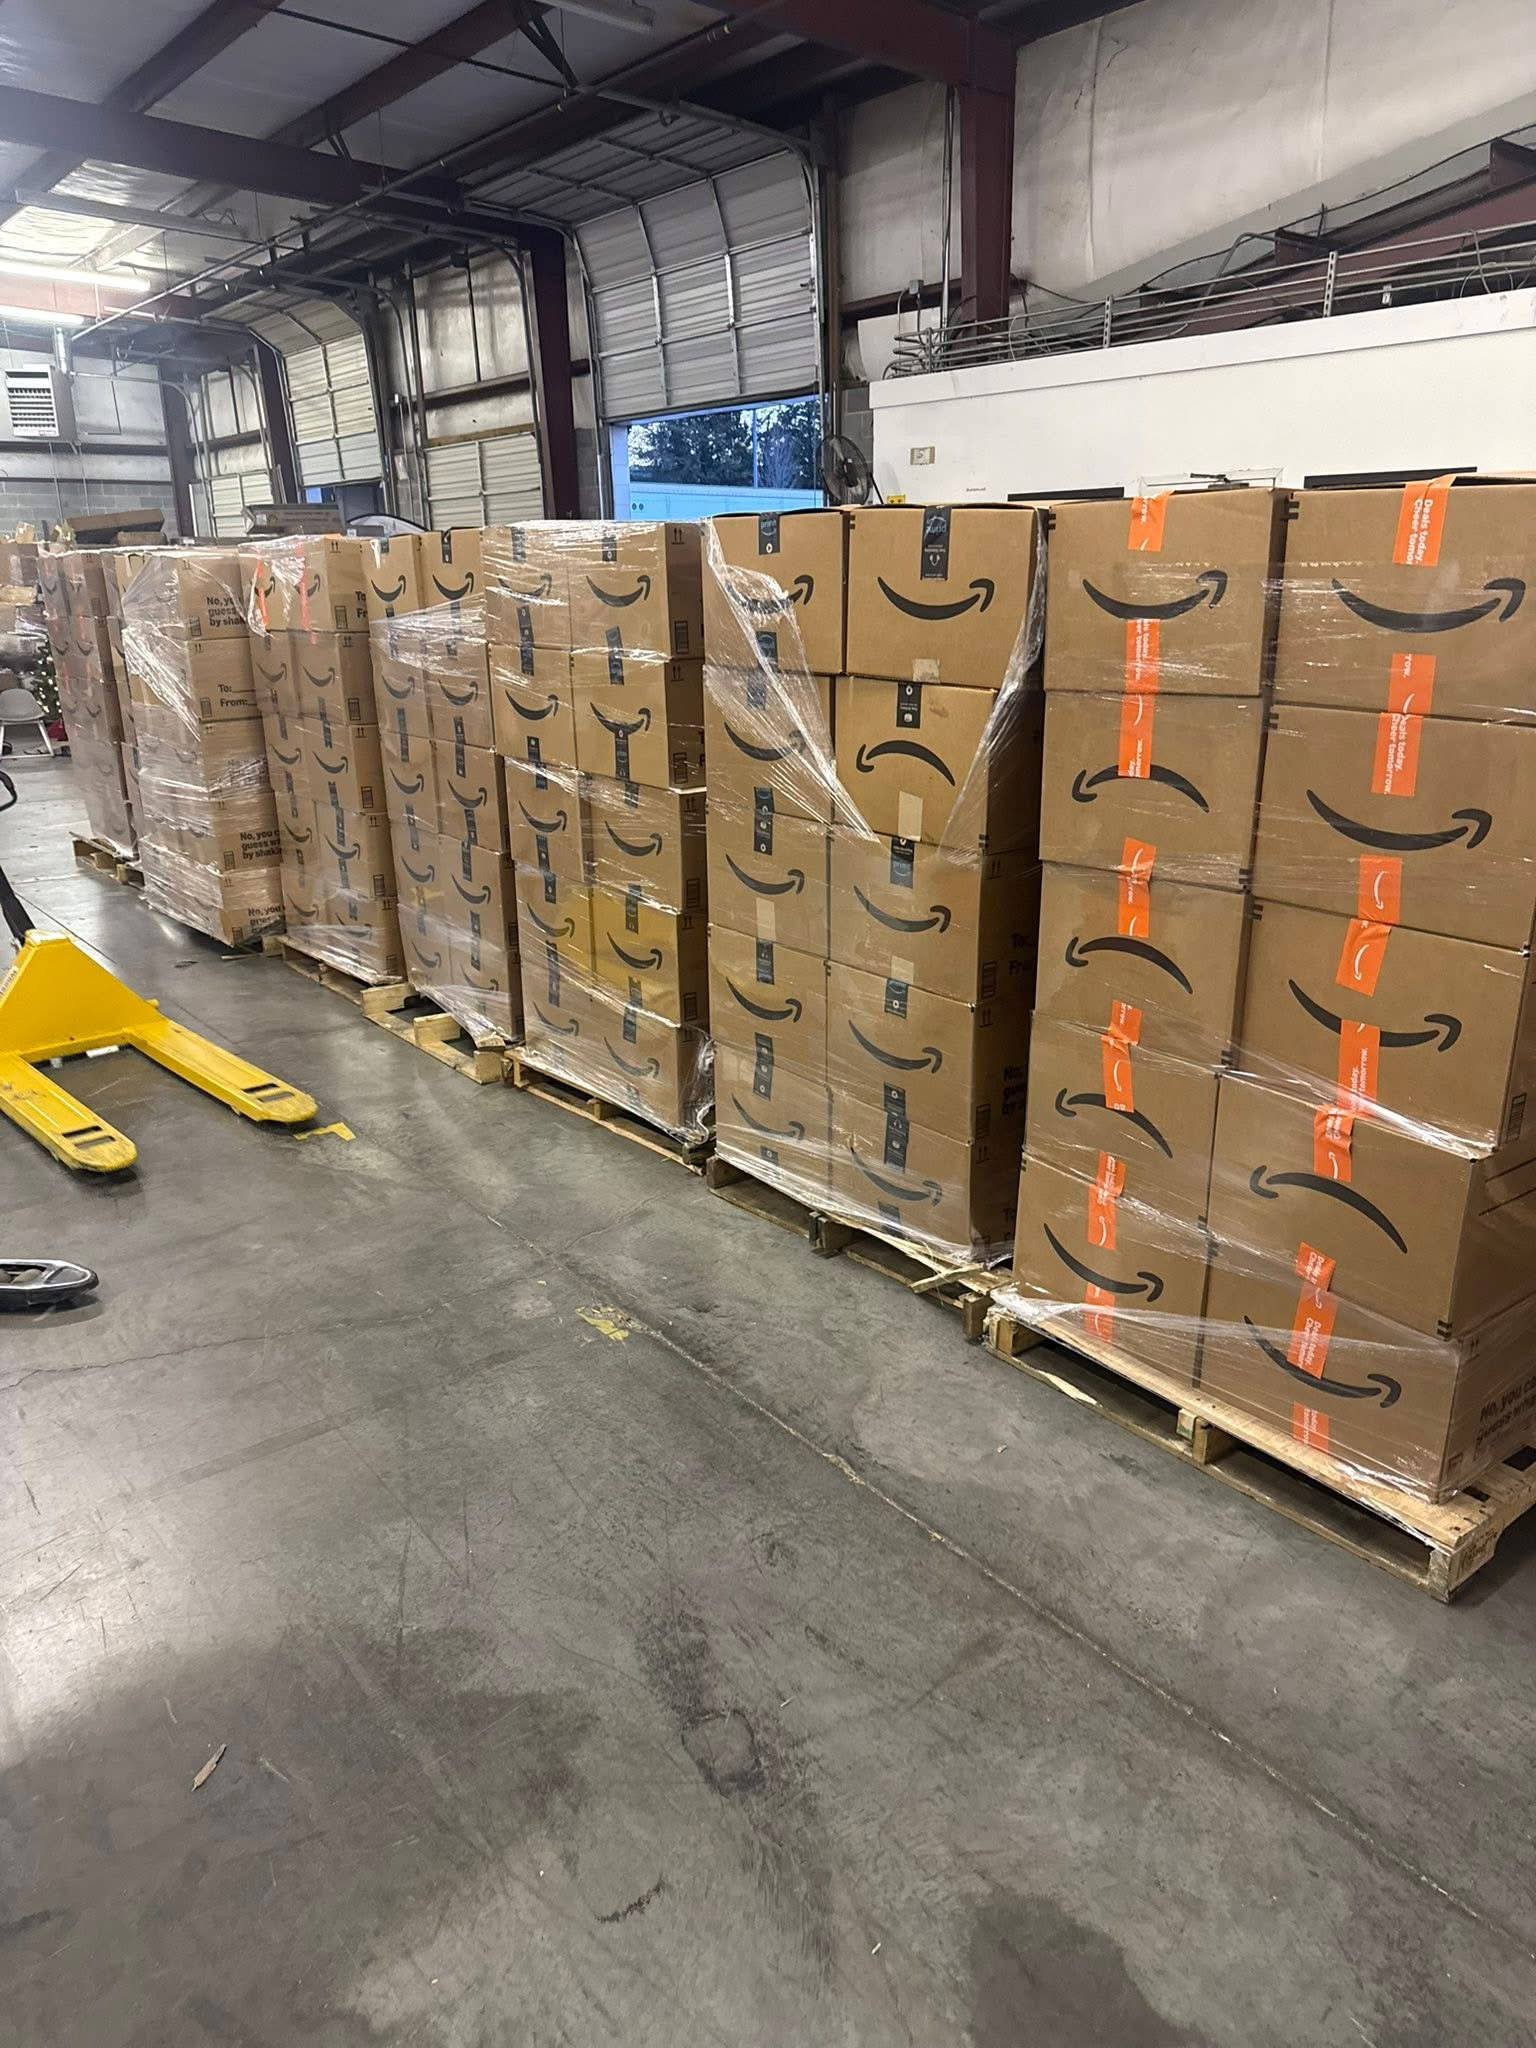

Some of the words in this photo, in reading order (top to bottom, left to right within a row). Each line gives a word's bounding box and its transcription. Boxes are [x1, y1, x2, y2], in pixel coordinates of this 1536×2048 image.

[1411, 498, 1424, 532] Cheer
[1420, 498, 1433, 530] Deals
[1414, 530, 1429, 562] today.
[209, 617, 220, 628] by
[1384, 742, 1398, 796] tomorrow.
[1395, 741, 1407, 772] today.
[240, 832, 255, 842] No,
[256, 831, 273, 841] you
